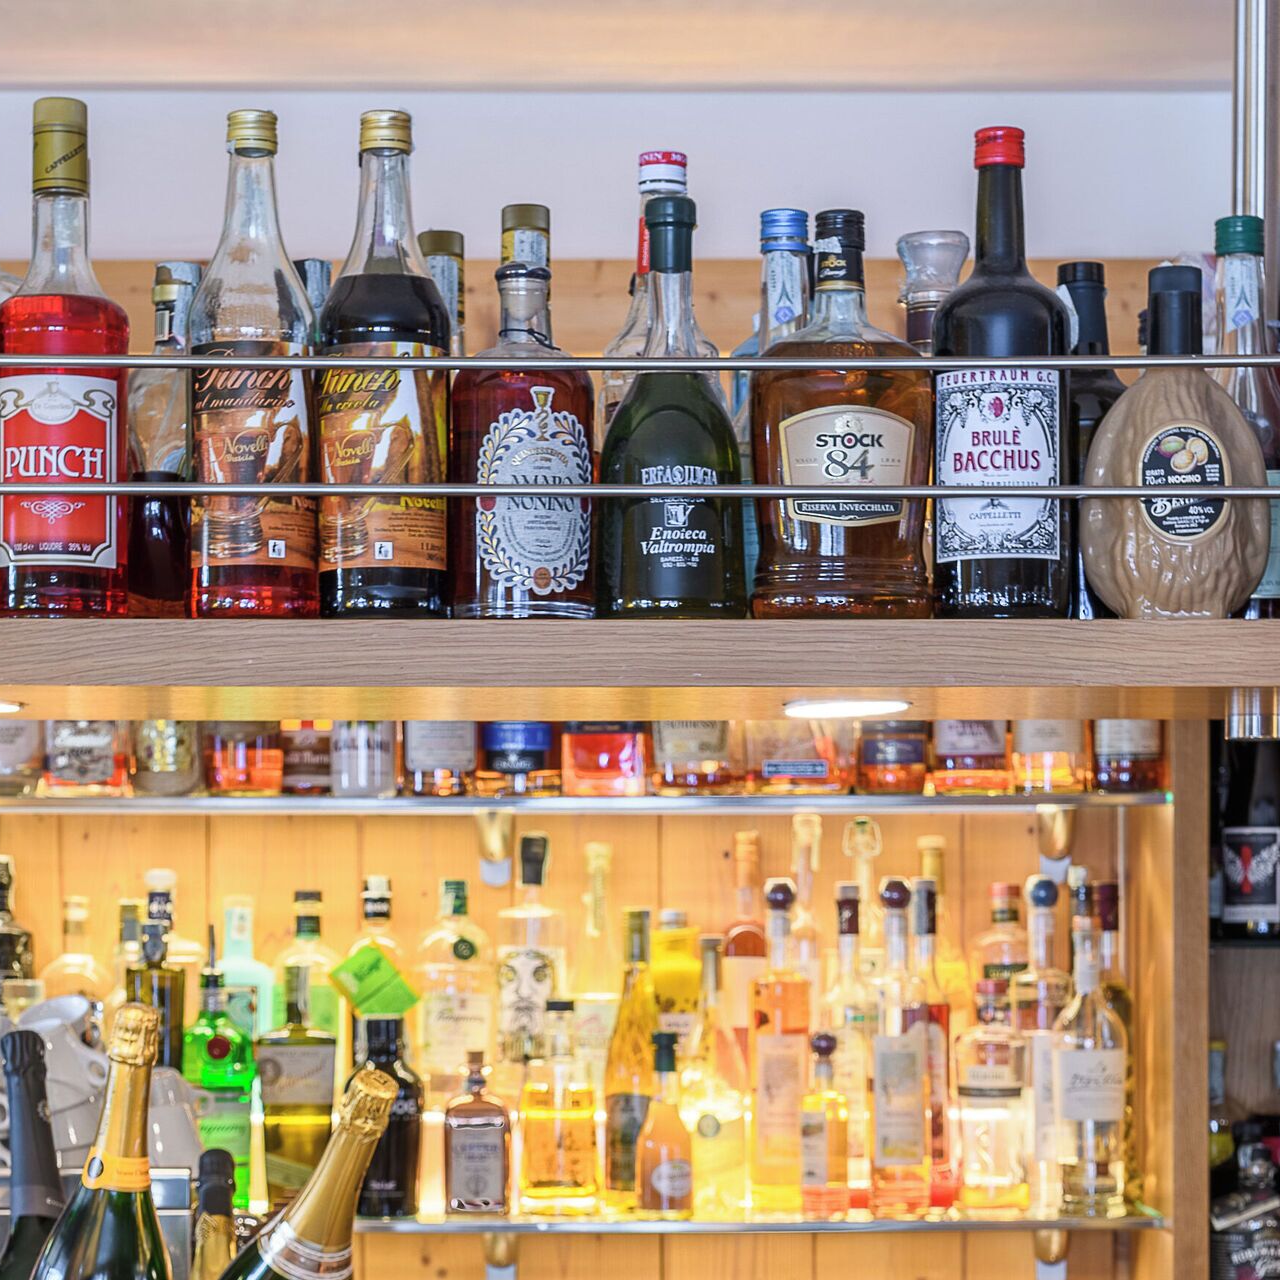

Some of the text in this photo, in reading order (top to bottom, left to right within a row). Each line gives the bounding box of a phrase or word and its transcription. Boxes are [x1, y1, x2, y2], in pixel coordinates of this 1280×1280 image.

[940, 369, 1029, 387] FEUERTRAUM
[816, 432, 884, 449] STOCK
[972, 426, 1022, 447] BRULÈ
[5, 445, 104, 479] PUNCH
[824, 449, 875, 478] 84
[953, 449, 1042, 473] BACCHUS
[1167, 474, 1202, 484] NOCINO
[801, 503, 837, 512] RISERVA
[650, 526, 707, 541] Enoteca
[640, 540, 716, 556] Valtrompia
